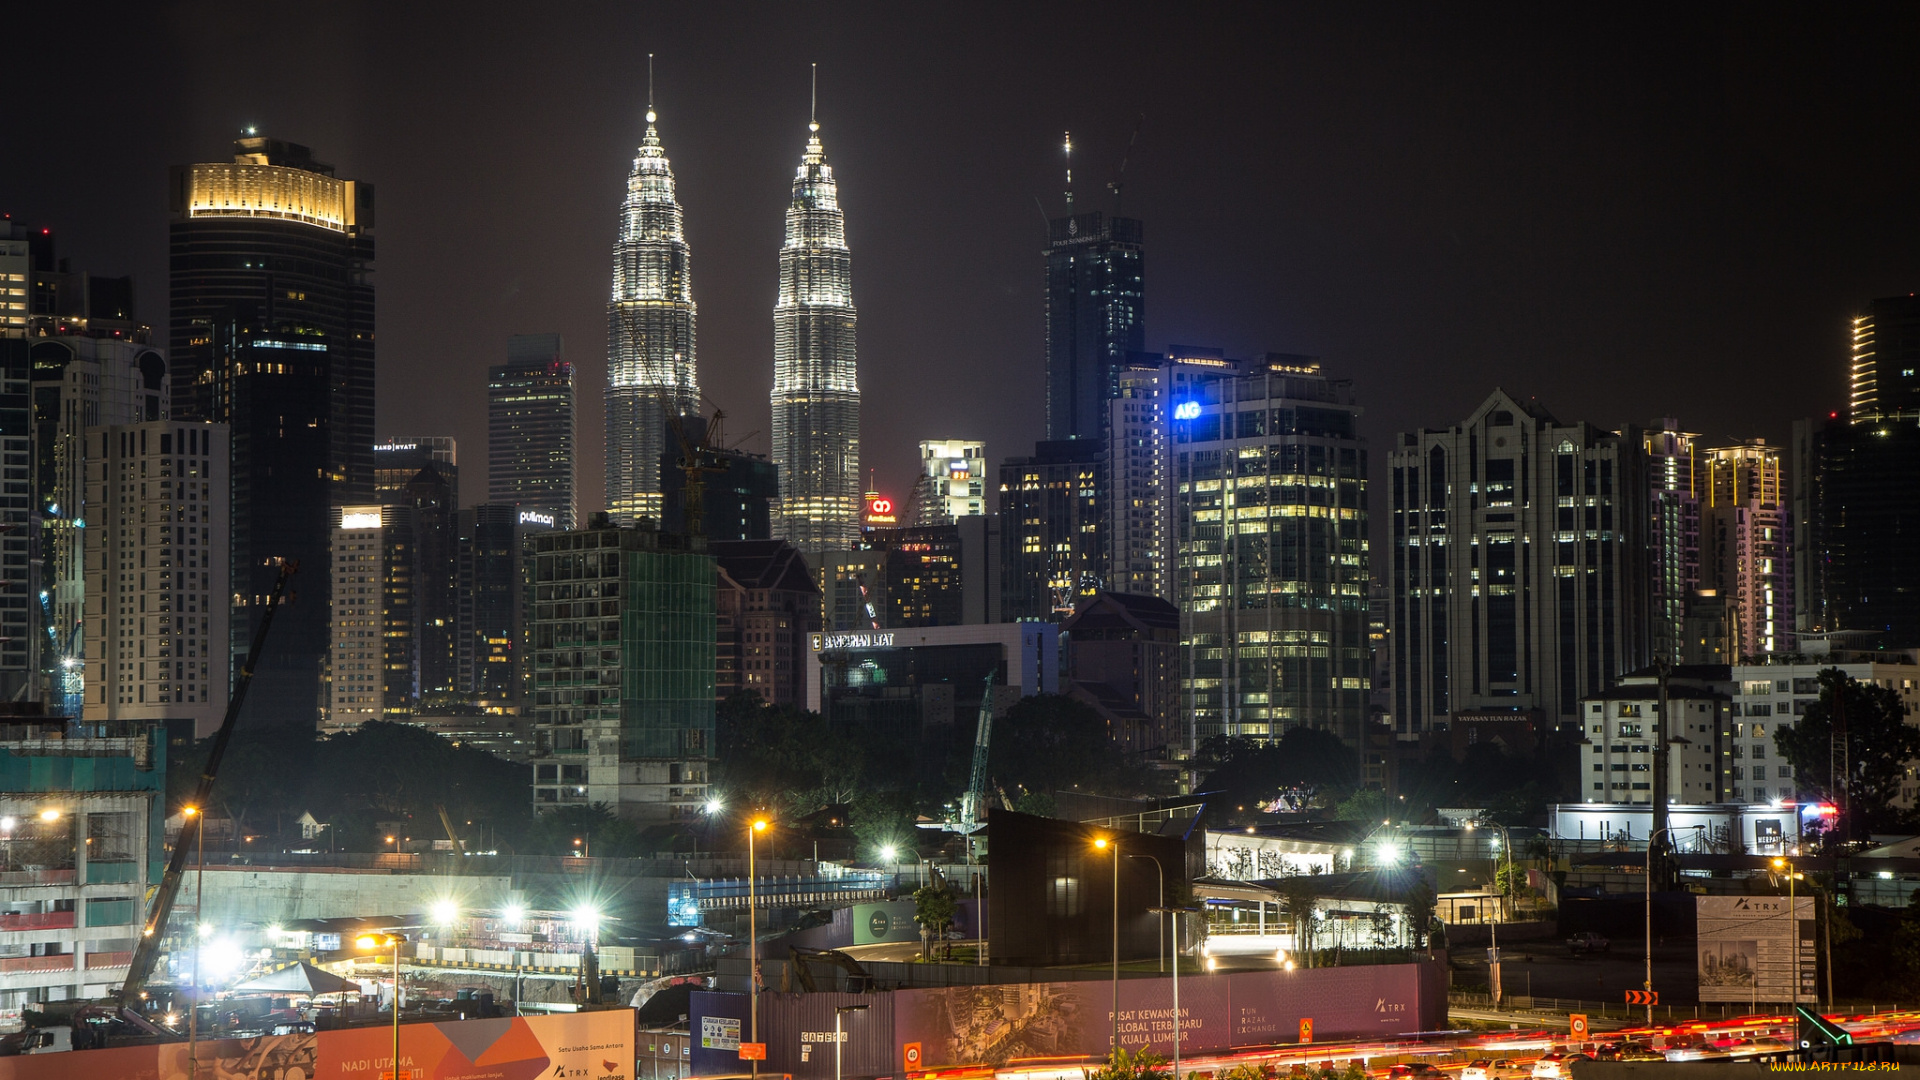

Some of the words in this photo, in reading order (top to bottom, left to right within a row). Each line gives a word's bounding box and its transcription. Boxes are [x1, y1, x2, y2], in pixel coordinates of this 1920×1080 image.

[1174, 401, 1201, 420] AIG
[519, 511, 554, 528] pullman
[1754, 903, 1779, 911] TRX
[1241, 1008, 1257, 1016] TUN
[1388, 1003, 1406, 1012] TRX
[1138, 1008, 1189, 1019] KEWANGAN
[1241, 1016, 1266, 1025] RAZAK
[1237, 1024, 1276, 1034] EXCHANGE
[1121, 1034, 1151, 1045] KUALA
[341, 1060, 370, 1072] NADI
[374, 1056, 414, 1069] UTAMA
[569, 1069, 589, 1077] TRX
